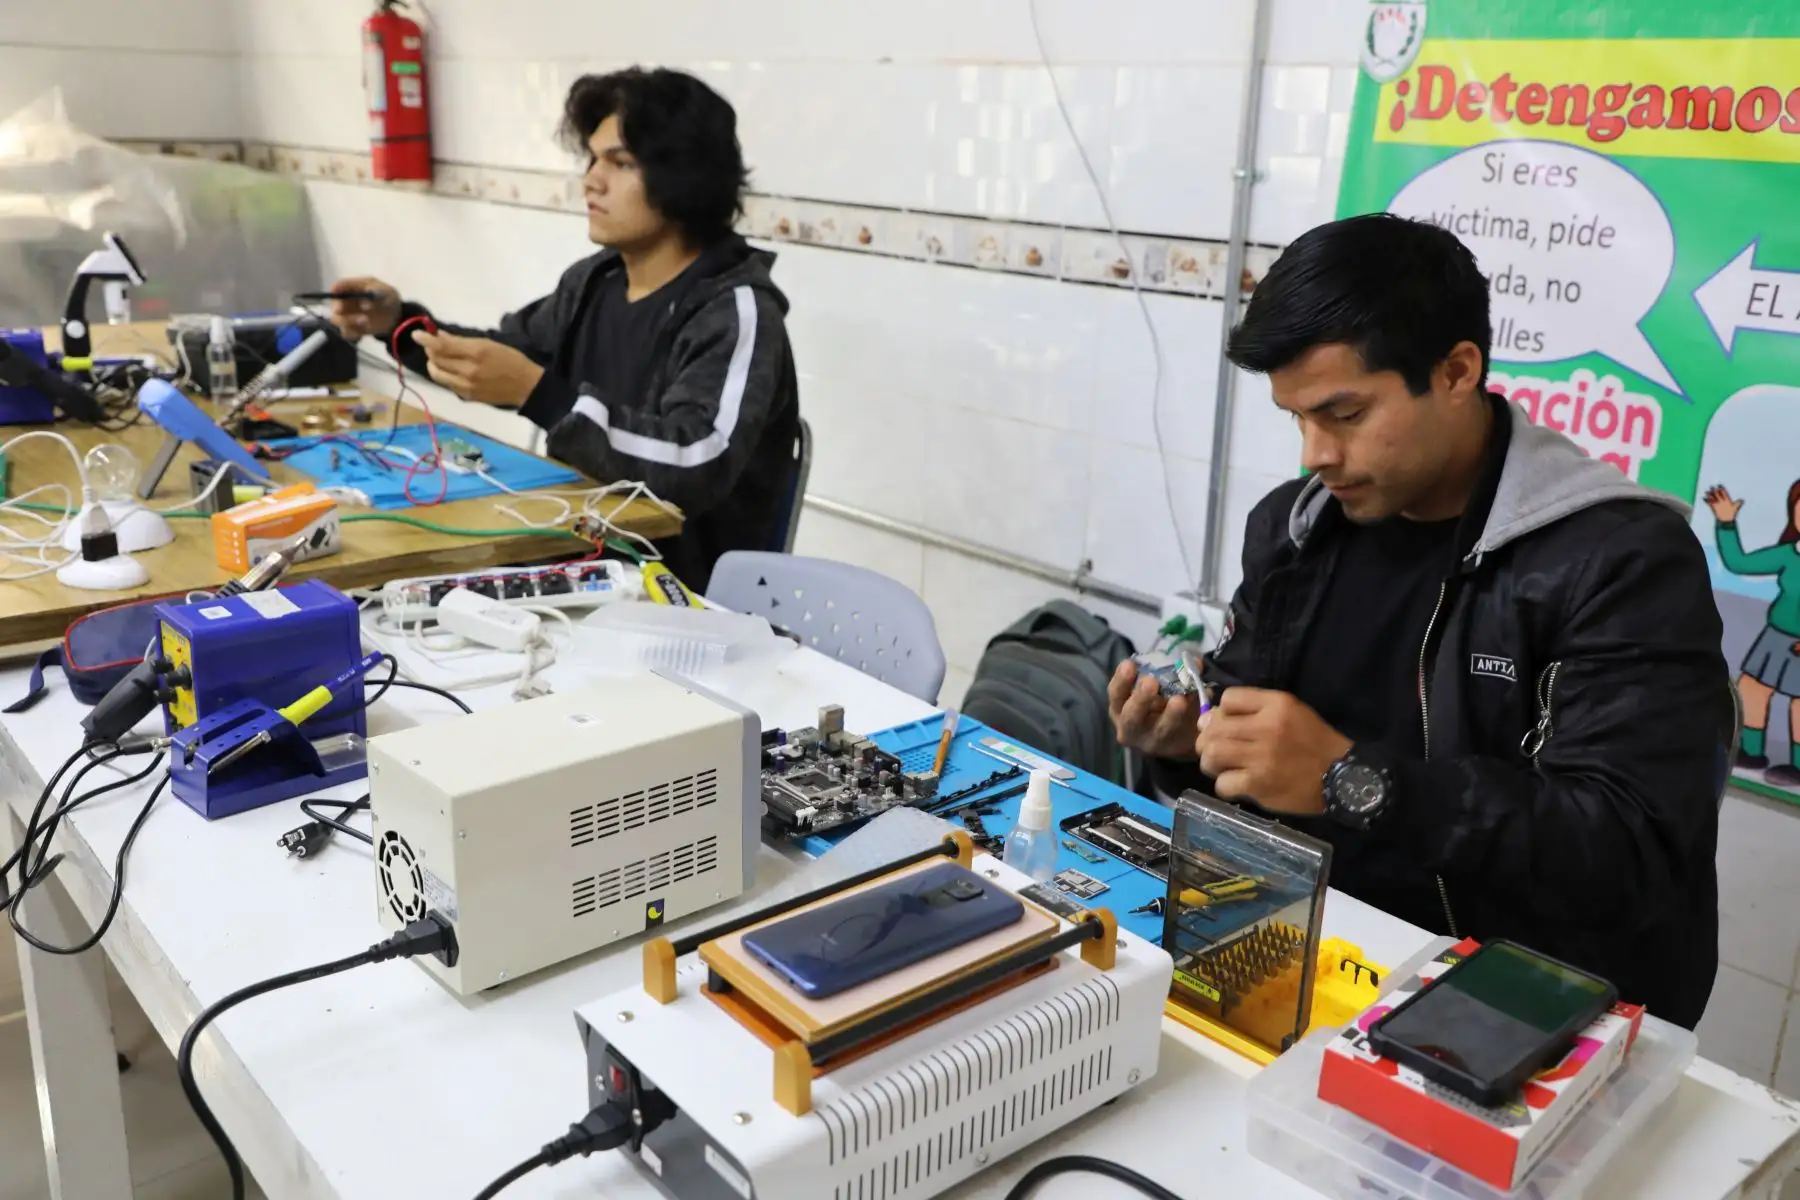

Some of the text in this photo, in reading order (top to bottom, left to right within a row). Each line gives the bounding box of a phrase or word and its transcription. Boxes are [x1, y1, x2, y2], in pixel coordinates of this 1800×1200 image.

[1389, 65, 1800, 142] ¡Detengamos
[1481, 152, 1578, 188] Si eres
[1547, 214, 1616, 252] pide
[1546, 279, 1581, 303] no
[1746, 282, 1784, 319] EL
